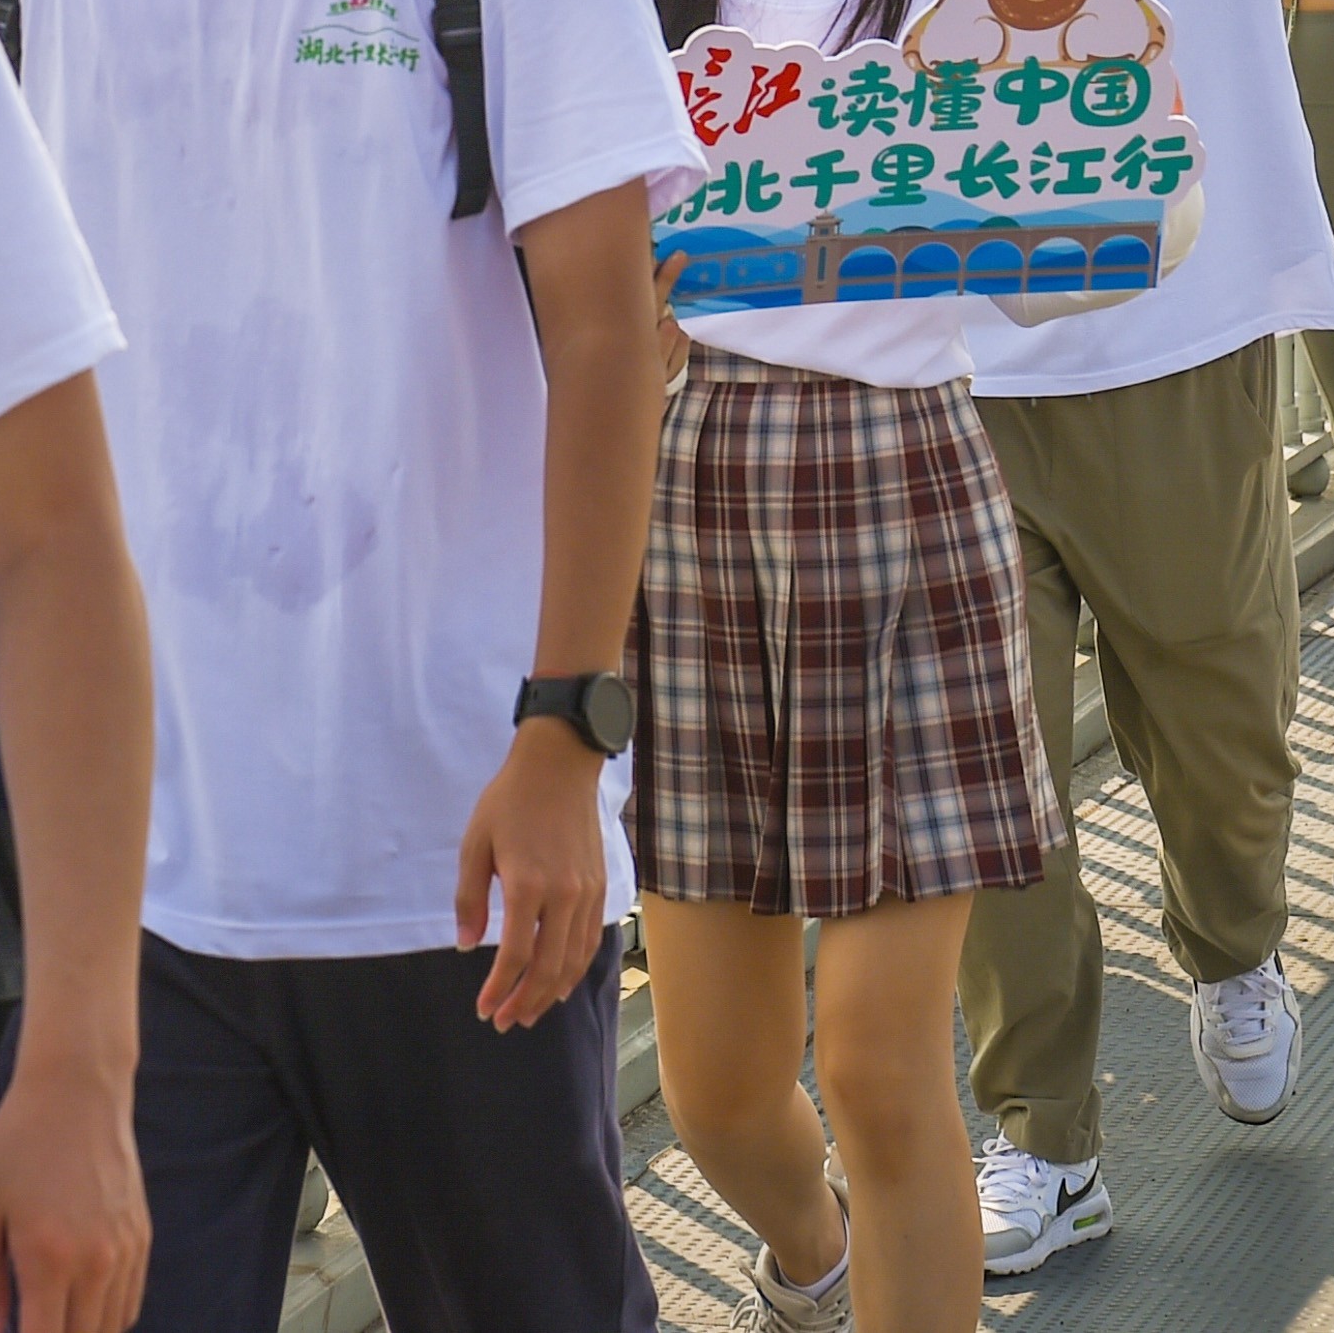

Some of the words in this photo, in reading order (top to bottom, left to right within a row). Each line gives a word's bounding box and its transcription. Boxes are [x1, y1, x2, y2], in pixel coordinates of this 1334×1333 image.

[653, 134, 1194, 224] 北千里长江行
